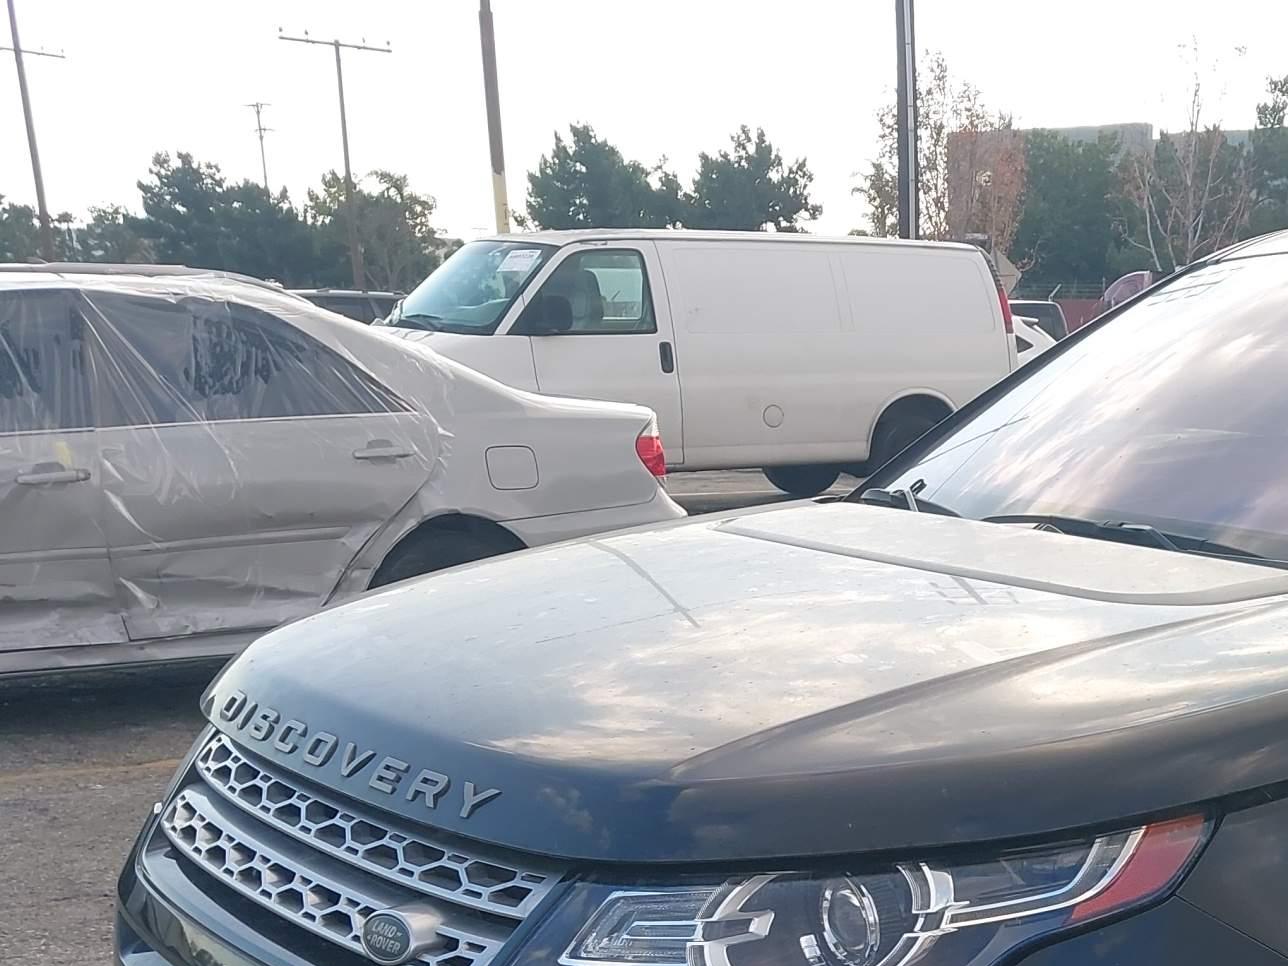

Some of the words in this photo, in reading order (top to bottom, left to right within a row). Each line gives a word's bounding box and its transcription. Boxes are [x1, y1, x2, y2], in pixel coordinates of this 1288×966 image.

[220, 690, 503, 818] DISCOVERY
[372, 920, 397, 938] LAND
[370, 934, 401, 954] ROVER
